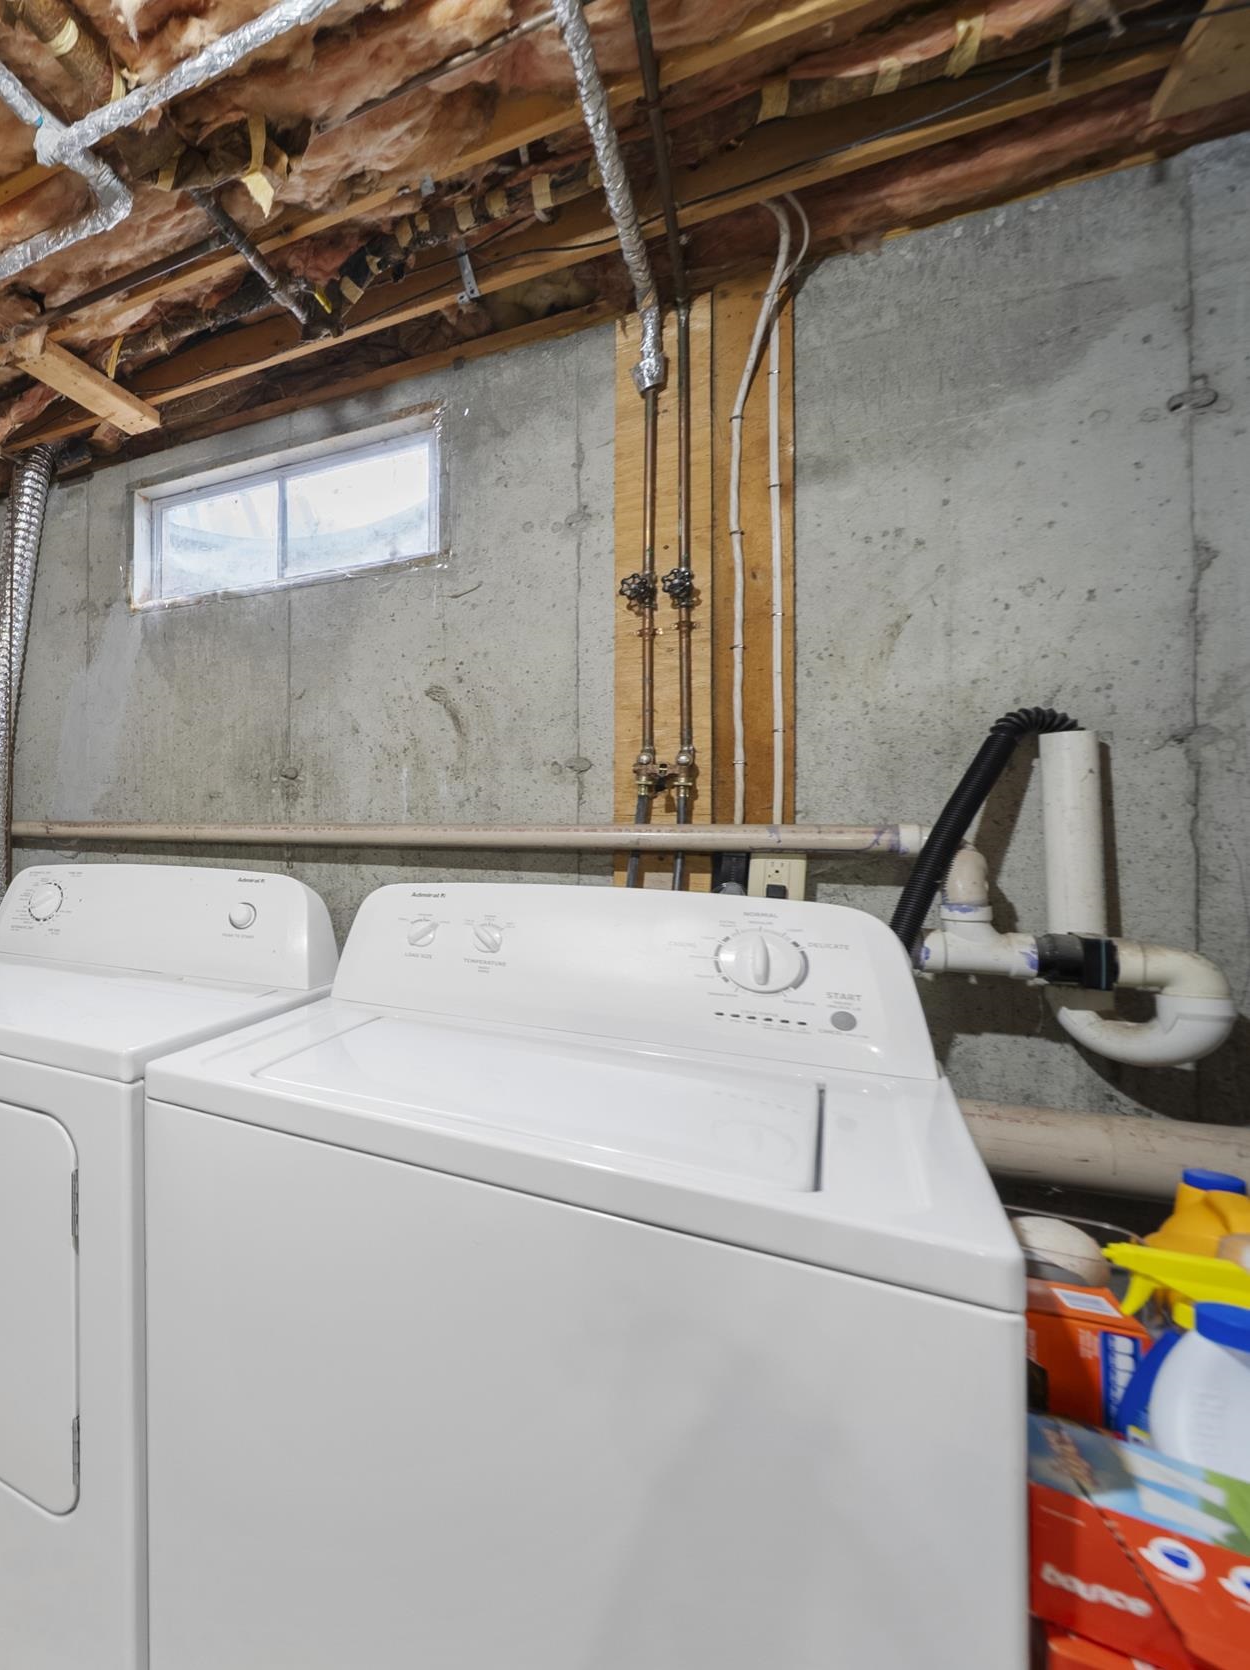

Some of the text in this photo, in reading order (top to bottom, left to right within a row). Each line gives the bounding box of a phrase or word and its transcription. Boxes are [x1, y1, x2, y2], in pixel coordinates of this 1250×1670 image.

[807, 942, 850, 951] DELICATE
[463, 957, 507, 967] TEMPERATURE
[825, 991, 863, 1001] START
